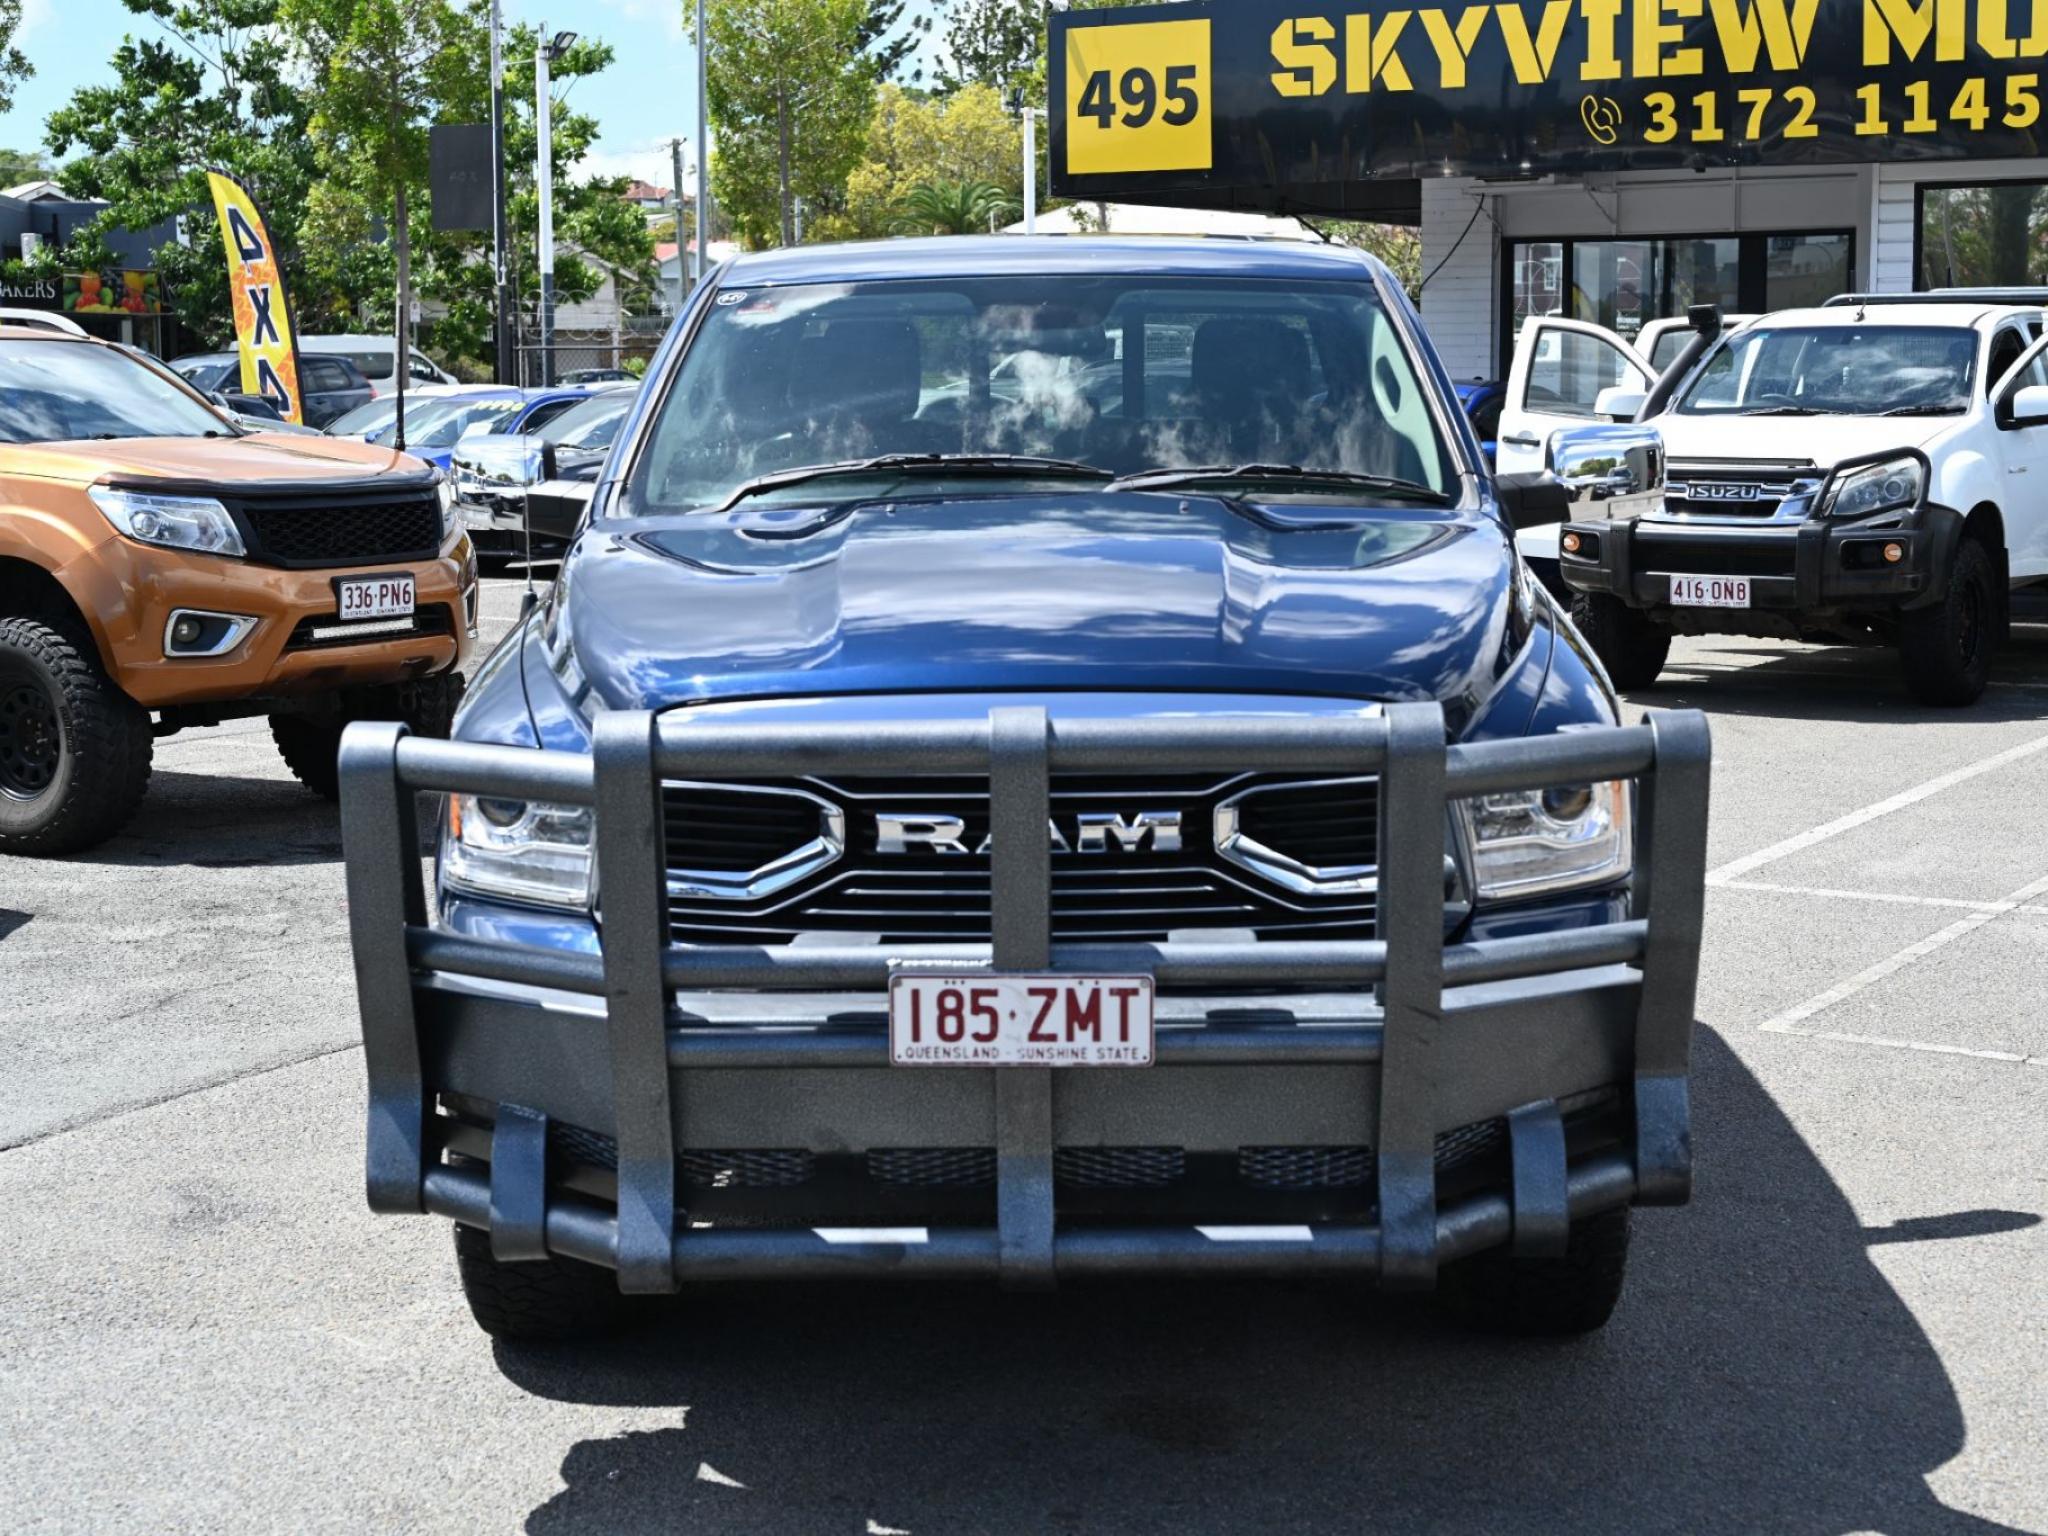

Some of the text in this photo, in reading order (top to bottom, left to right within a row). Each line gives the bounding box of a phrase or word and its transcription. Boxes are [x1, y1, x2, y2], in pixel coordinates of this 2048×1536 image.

[1271, 0, 1818, 97] SKYVIEW
[1078, 65, 1199, 129] 495
[1643, 74, 2039, 143] 3172 1145
[0, 279, 55, 299] AKERS
[1690, 486, 1755, 498] ISUZU
[876, 812, 1182, 853] RM
[905, 1047, 1138, 1060] QUEENSLAND SUNSHINE STATE
